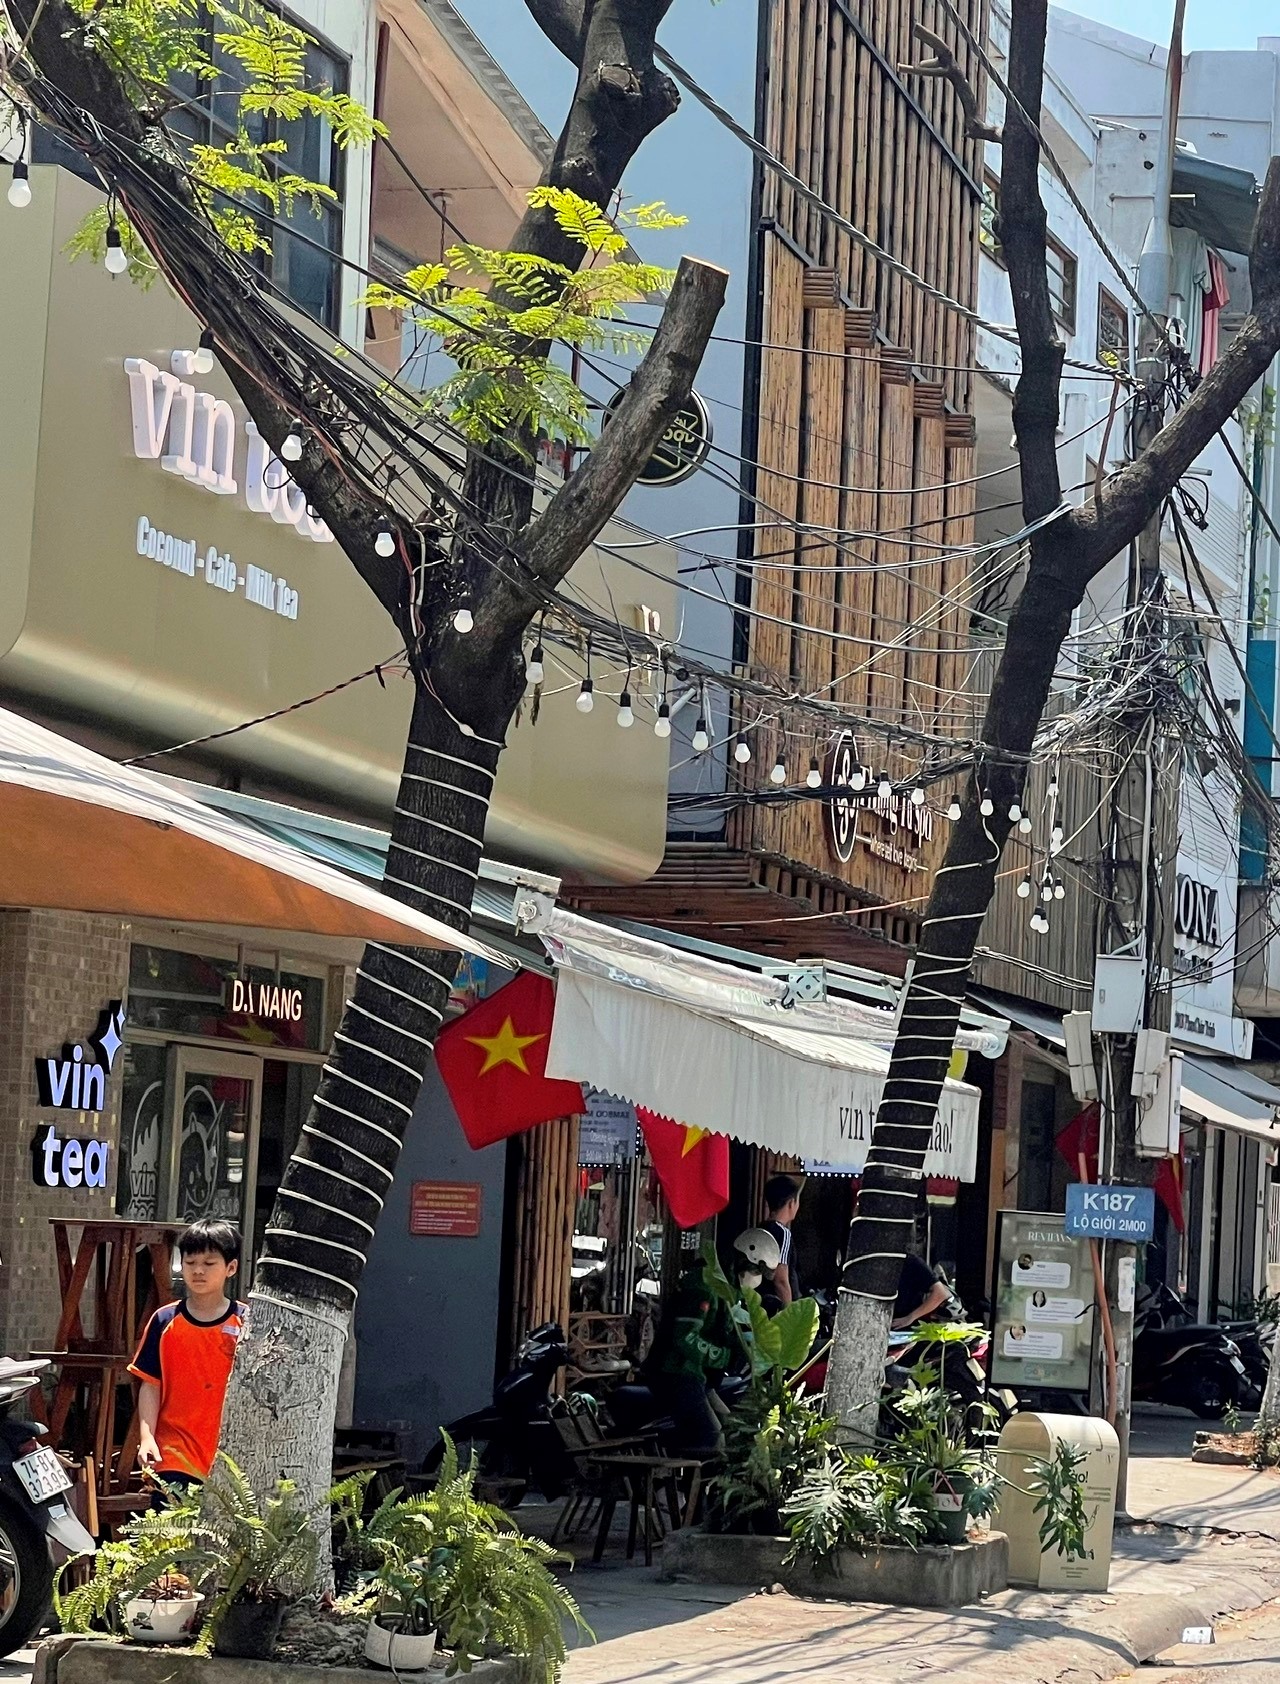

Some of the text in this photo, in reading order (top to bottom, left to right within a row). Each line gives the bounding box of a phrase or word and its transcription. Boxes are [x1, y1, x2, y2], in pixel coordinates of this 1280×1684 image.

[123, 349, 238, 495] vin
[137, 515, 197, 577] Coconut
[245, 563, 276, 611] Milk
[276, 577, 299, 620] Tea
[258, 984, 303, 1022] NANG
[48, 1045, 106, 1111] vin
[840, 1091, 865, 1142] vin
[43, 1126, 110, 1188] tea
[1073, 1215, 1147, 1232] LỘ GIỚI 2M00
[1083, 1192, 1136, 1212] K187
[28, 1469, 69, 1498] 323.95
